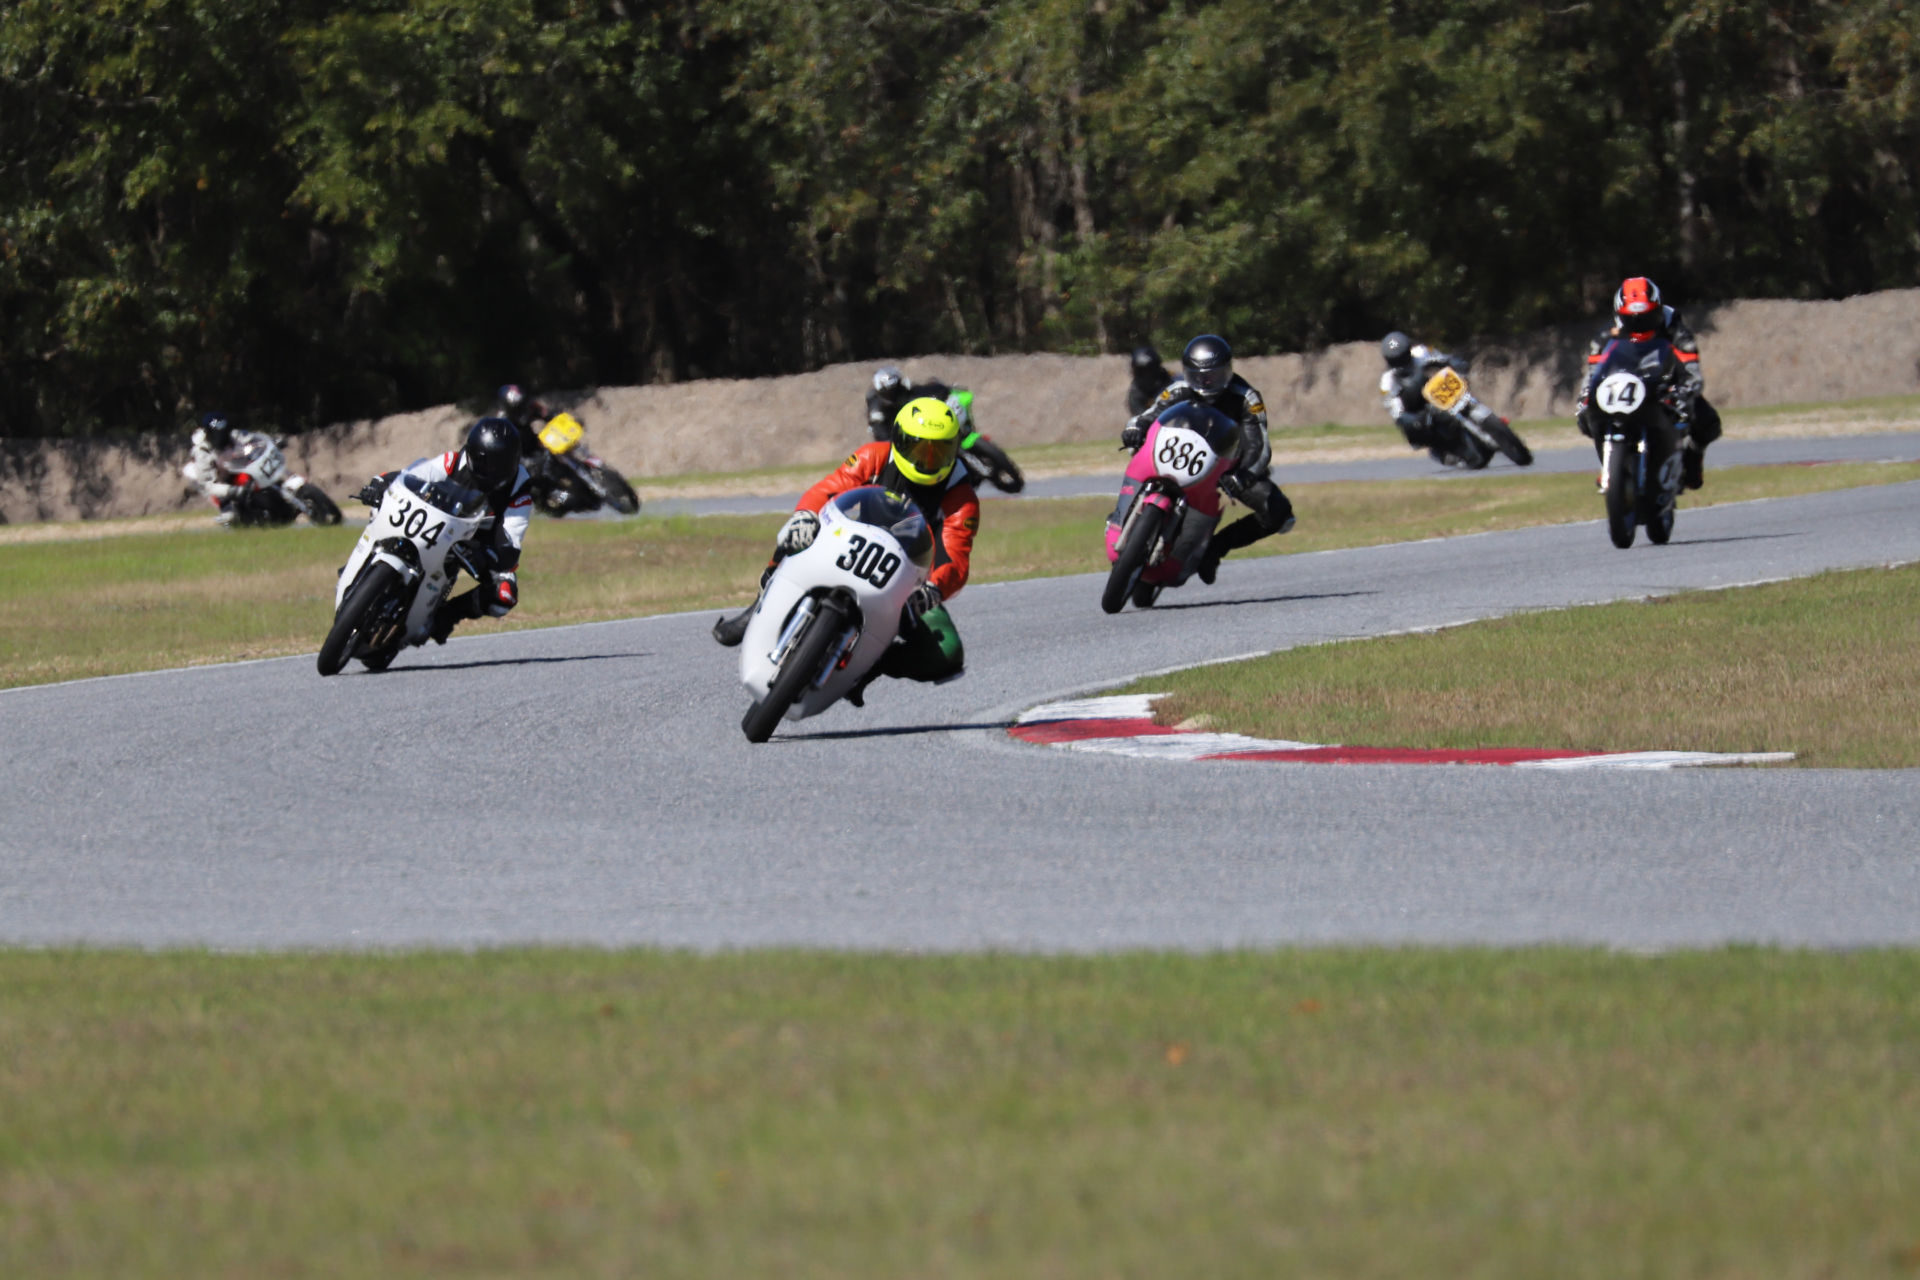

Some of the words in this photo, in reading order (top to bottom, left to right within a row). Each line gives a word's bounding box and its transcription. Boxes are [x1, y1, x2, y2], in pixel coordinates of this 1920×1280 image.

[1606, 381, 1637, 407] 14
[1159, 435, 1207, 477] 886
[389, 498, 446, 551] 304
[836, 534, 902, 590] 309
